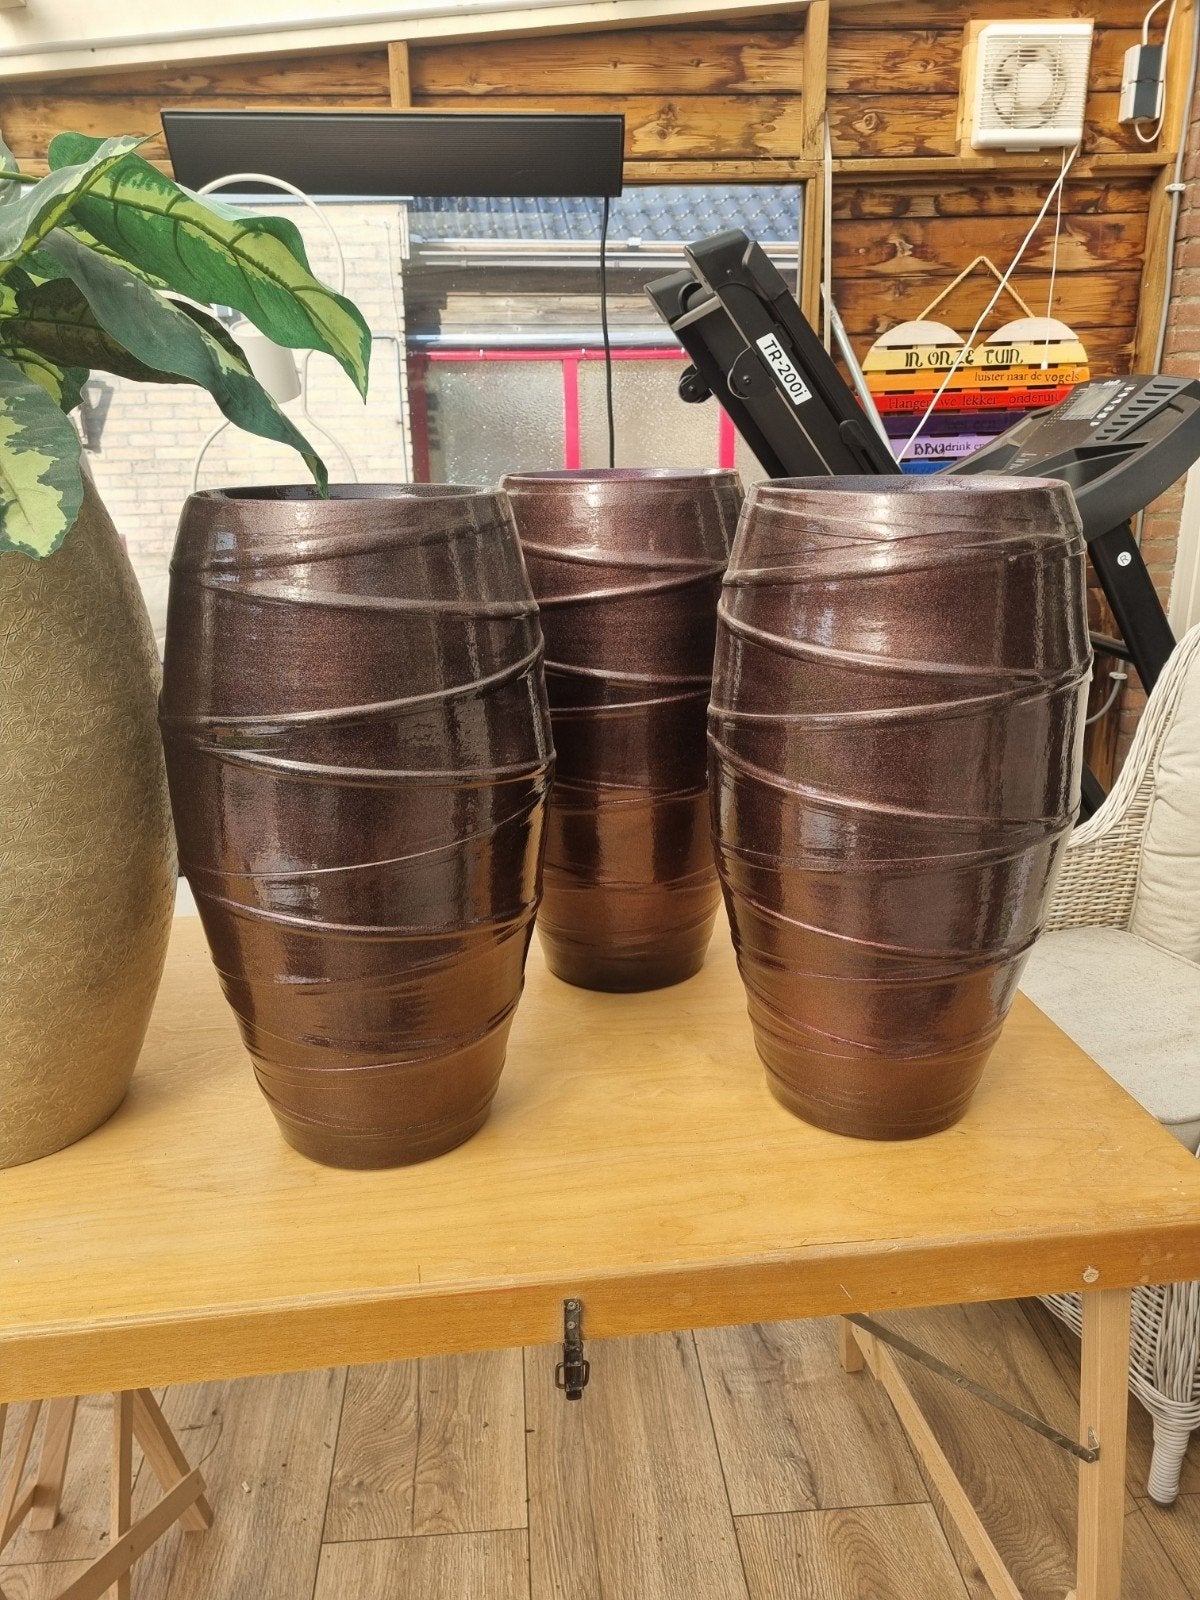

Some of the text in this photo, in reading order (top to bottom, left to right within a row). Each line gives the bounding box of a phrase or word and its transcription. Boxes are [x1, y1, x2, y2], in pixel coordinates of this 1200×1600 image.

[764, 340, 807, 398] TR-200i
[974, 370, 1080, 385] luister naar de vogels
[940, 398, 957, 407] we
[962, 395, 996, 406] lekker
[1009, 392, 1060, 404] onderuit
[914, 442, 945, 456] BBQ
[944, 442, 972, 452] drink
